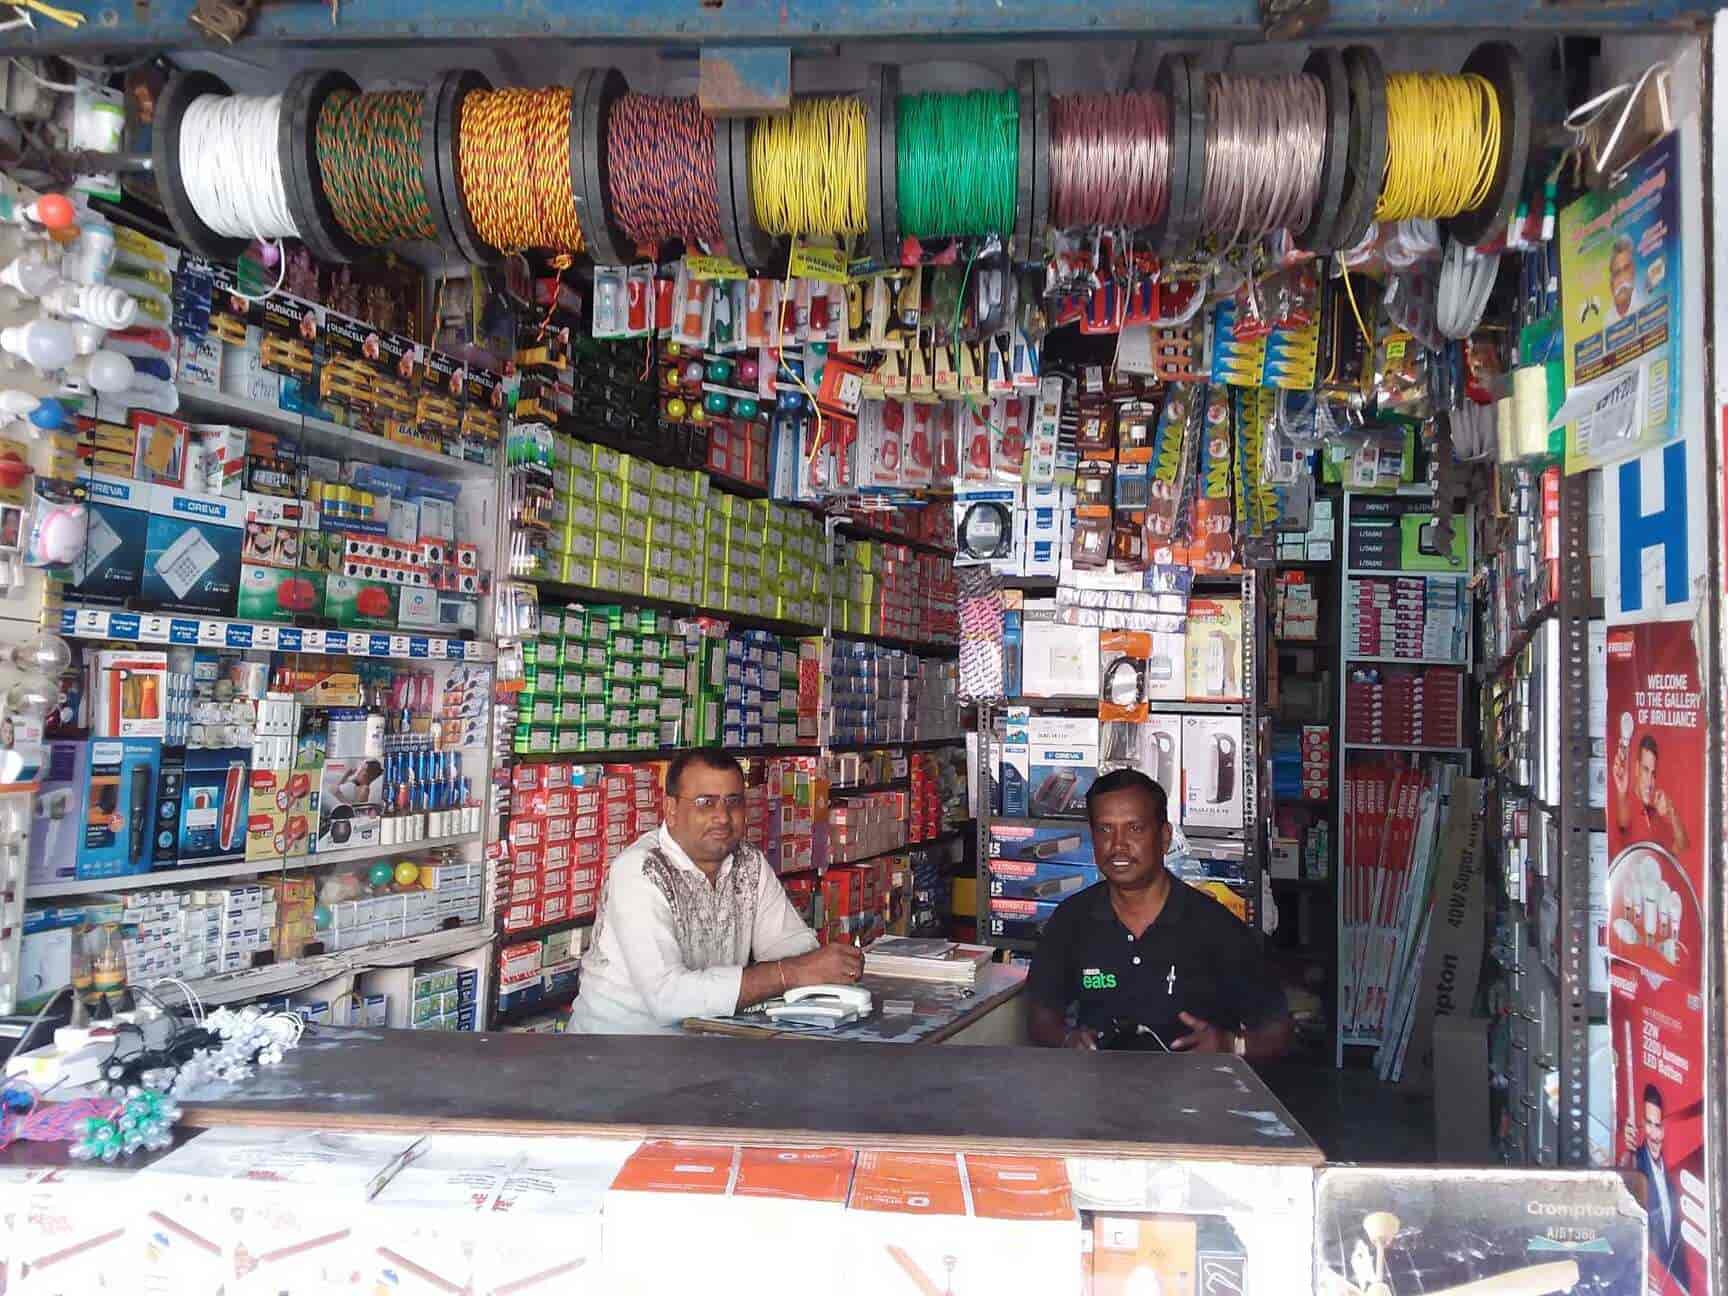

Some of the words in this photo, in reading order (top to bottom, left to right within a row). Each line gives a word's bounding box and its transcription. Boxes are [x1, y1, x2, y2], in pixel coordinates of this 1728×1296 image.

[266, 302, 303, 321] DURACELL
[187, 501, 222, 515] OREVA
[1619, 440, 1689, 612] H
[1647, 674, 1688, 690] WELCOME
[1635, 692, 1646, 708] TO
[1647, 692, 1664, 708] THE
[1664, 693, 1700, 710] GALLERY
[1638, 709, 1649, 725] OF
[1650, 710, 1697, 728] BRILLIANCE
[1083, 974, 1117, 990] eats
[1527, 1200, 1617, 1219] Crompton
